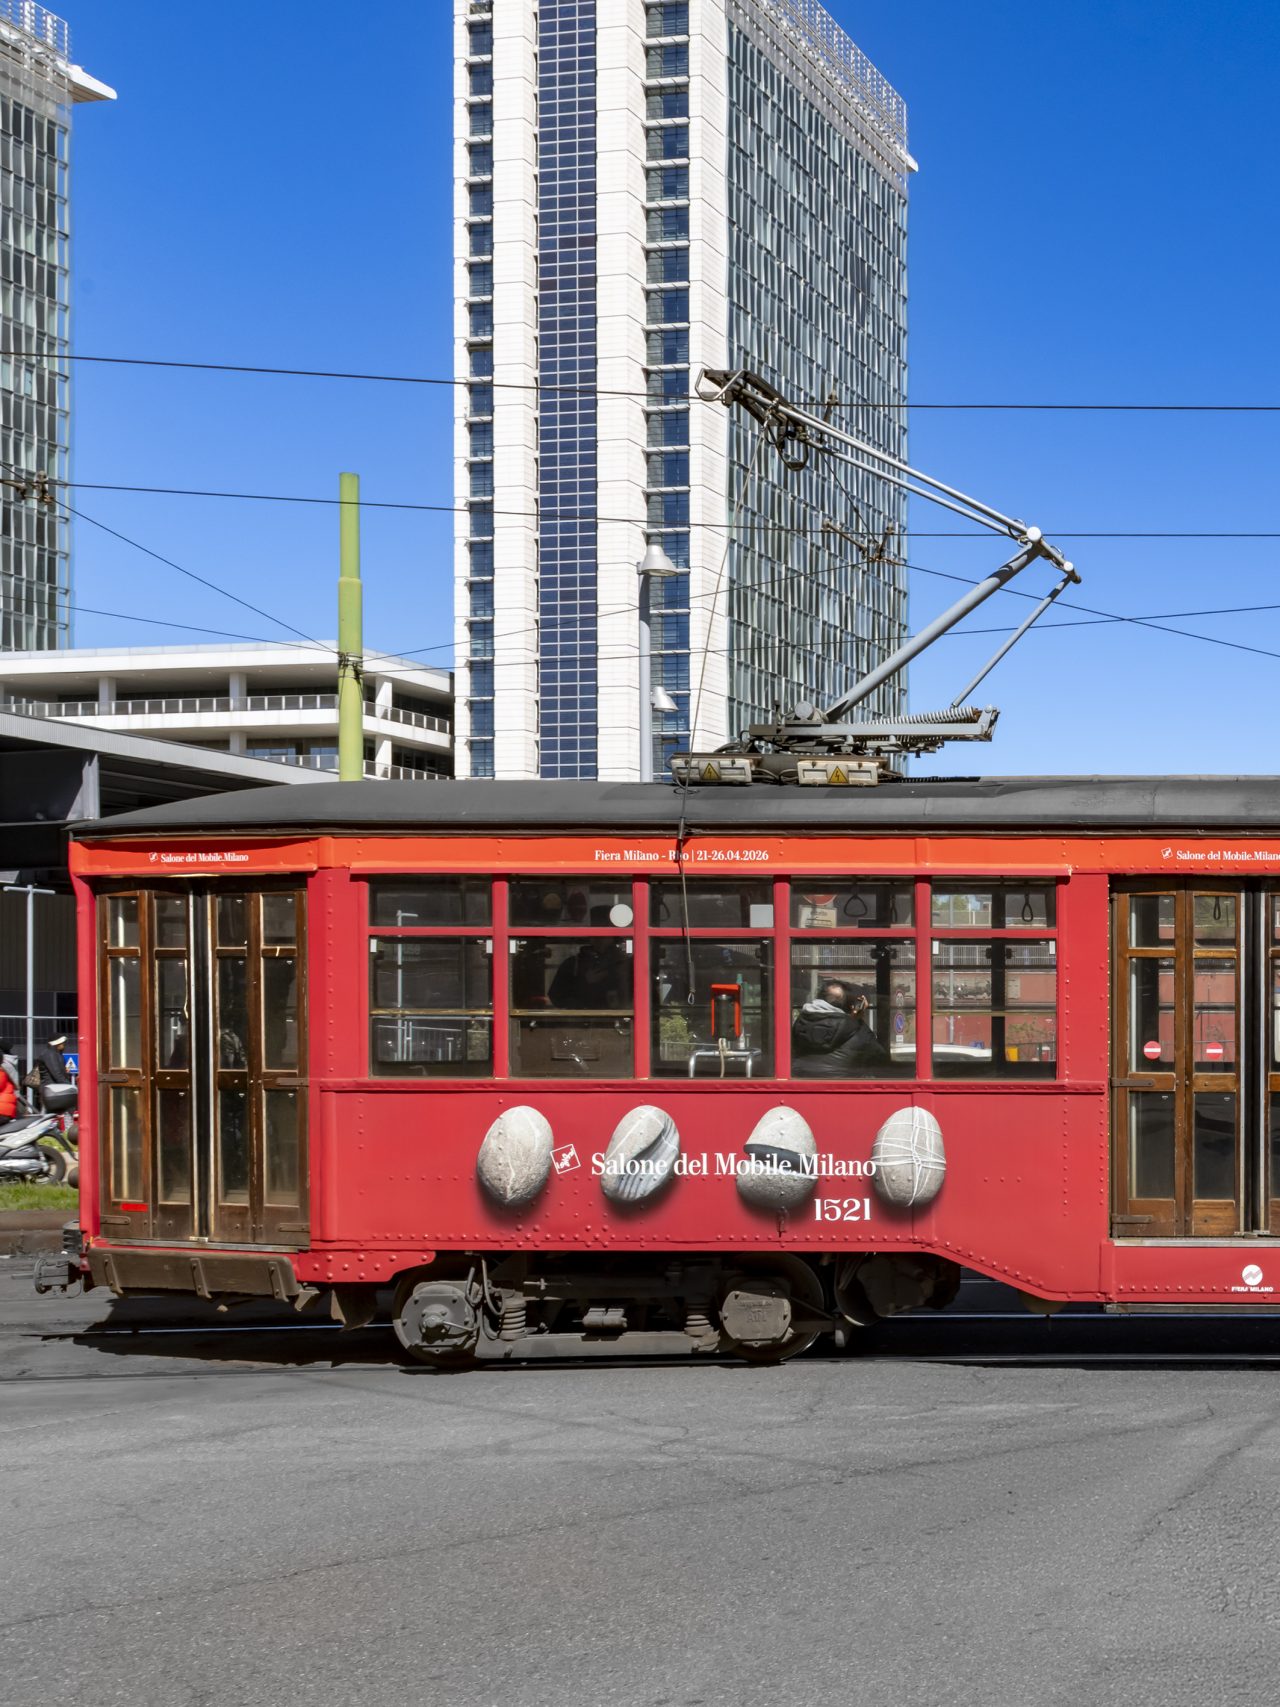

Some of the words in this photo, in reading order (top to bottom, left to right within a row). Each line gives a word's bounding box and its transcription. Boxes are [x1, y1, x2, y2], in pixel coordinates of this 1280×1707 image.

[160, 853, 185, 863] Salone
[185, 853, 197, 862] del
[594, 850, 621, 861] Fiera
[623, 850, 659, 861] Milano
[697, 850, 769, 861] 21-26.04.2026
[1176, 850, 1206, 861] Salone
[1207, 851, 1221, 860] del
[591, 1152, 667, 1177] Salone
[673, 1152, 708, 1177] del
[714, 1152, 877, 1178] Mobile.Milano
[813, 1198, 872, 1222] 1521
